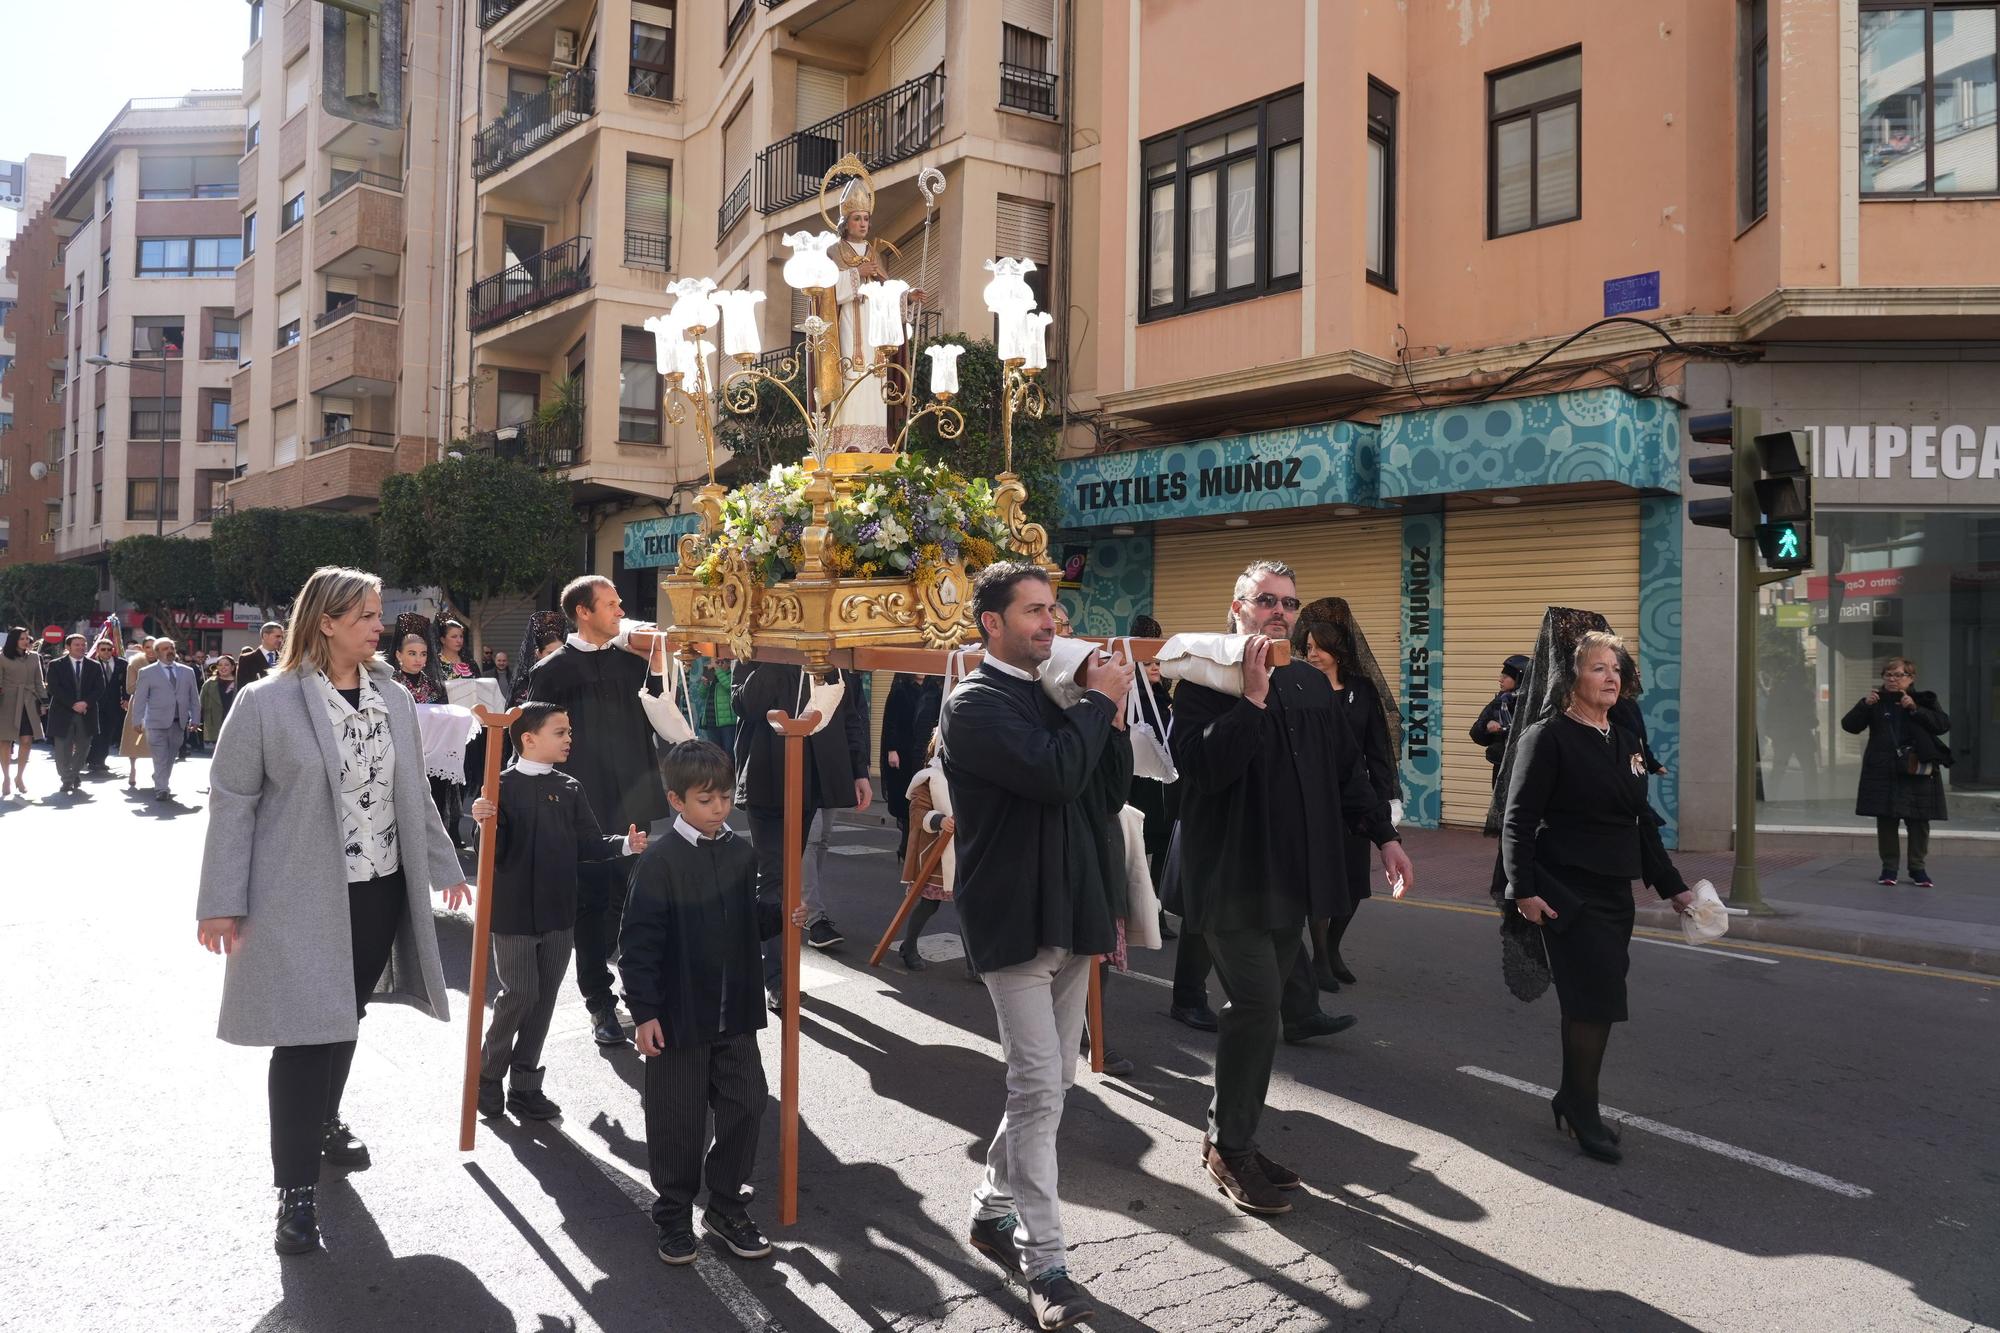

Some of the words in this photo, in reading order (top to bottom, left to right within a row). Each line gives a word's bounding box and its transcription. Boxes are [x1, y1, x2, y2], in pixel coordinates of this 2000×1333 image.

[1609, 296, 1652, 313] HOSPITAL
[1076, 471, 1187, 511] TEXTILES
[1200, 454, 1303, 498] MUÑOZ
[1405, 546, 1431, 635] MUÑOZ
[1408, 647, 1430, 760] TEXTILES
